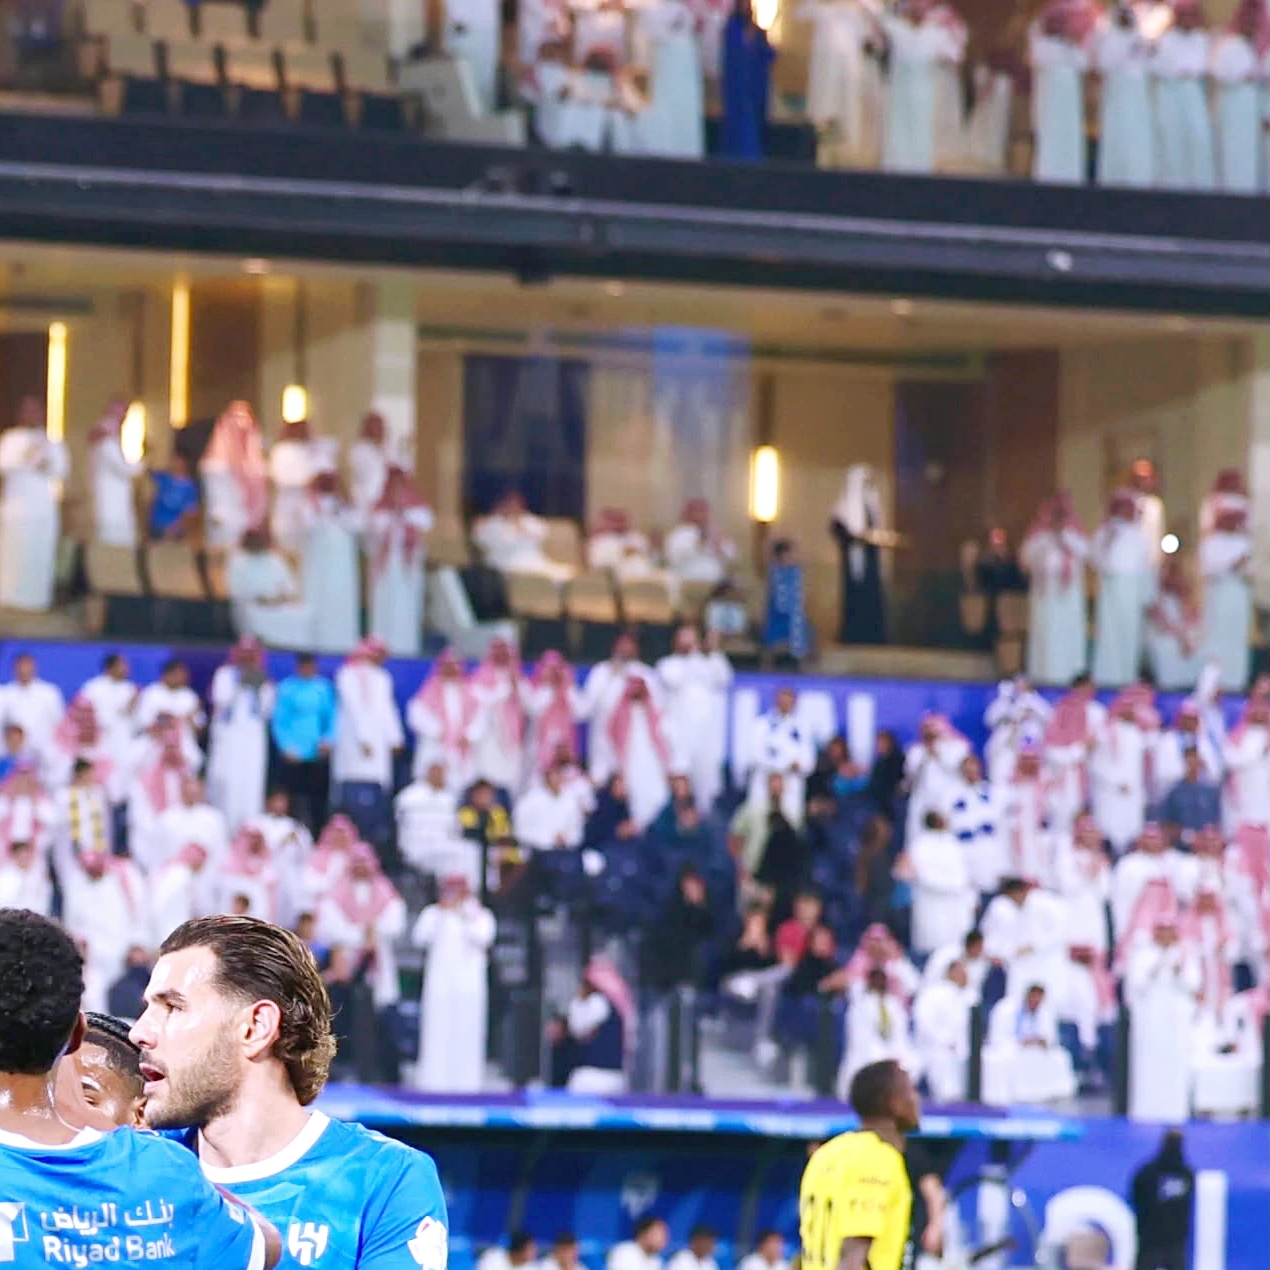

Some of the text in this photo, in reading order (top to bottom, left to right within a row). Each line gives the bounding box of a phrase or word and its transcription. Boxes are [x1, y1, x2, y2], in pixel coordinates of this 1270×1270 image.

[40, 1198, 175, 1236] بنك الرياض
[43, 1232, 176, 1268] Riyad Bank
